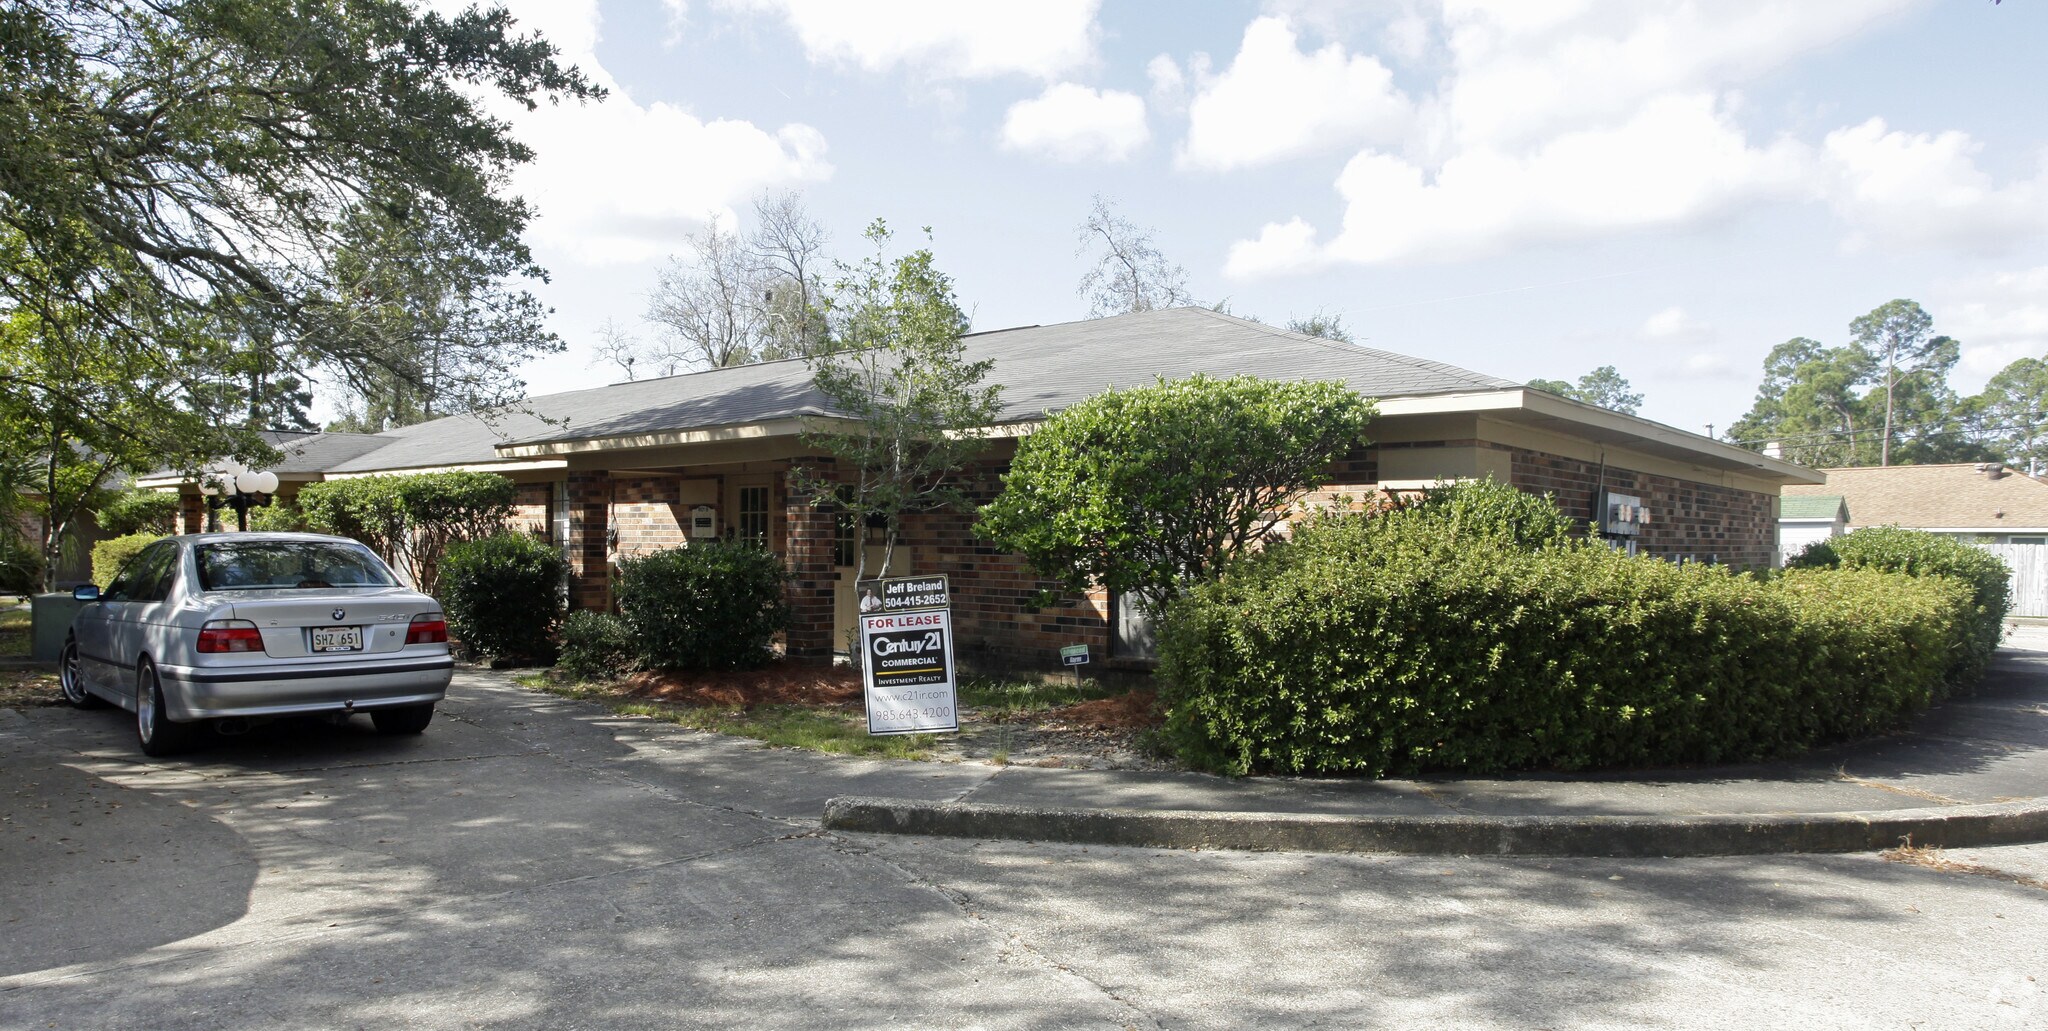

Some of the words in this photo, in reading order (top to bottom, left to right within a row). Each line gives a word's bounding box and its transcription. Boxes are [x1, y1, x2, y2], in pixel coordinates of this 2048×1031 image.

[887, 584, 904, 594] Jeff
[906, 581, 942, 591] Breland
[885, 594, 946, 607] 504-415-2652
[868, 618, 894, 629] FOR
[898, 615, 941, 627] LEASE
[315, 634, 335, 646] SHZ
[341, 633, 359, 645] 651
[873, 637, 926, 656] Century
[925, 632, 941, 650] 21
[881, 657, 937, 667] COMMERCIAL
[878, 677, 917, 685] INVESTMENT
[875, 691, 948, 702] www.c21ir.com
[876, 707, 950, 720] 985.643.4200
